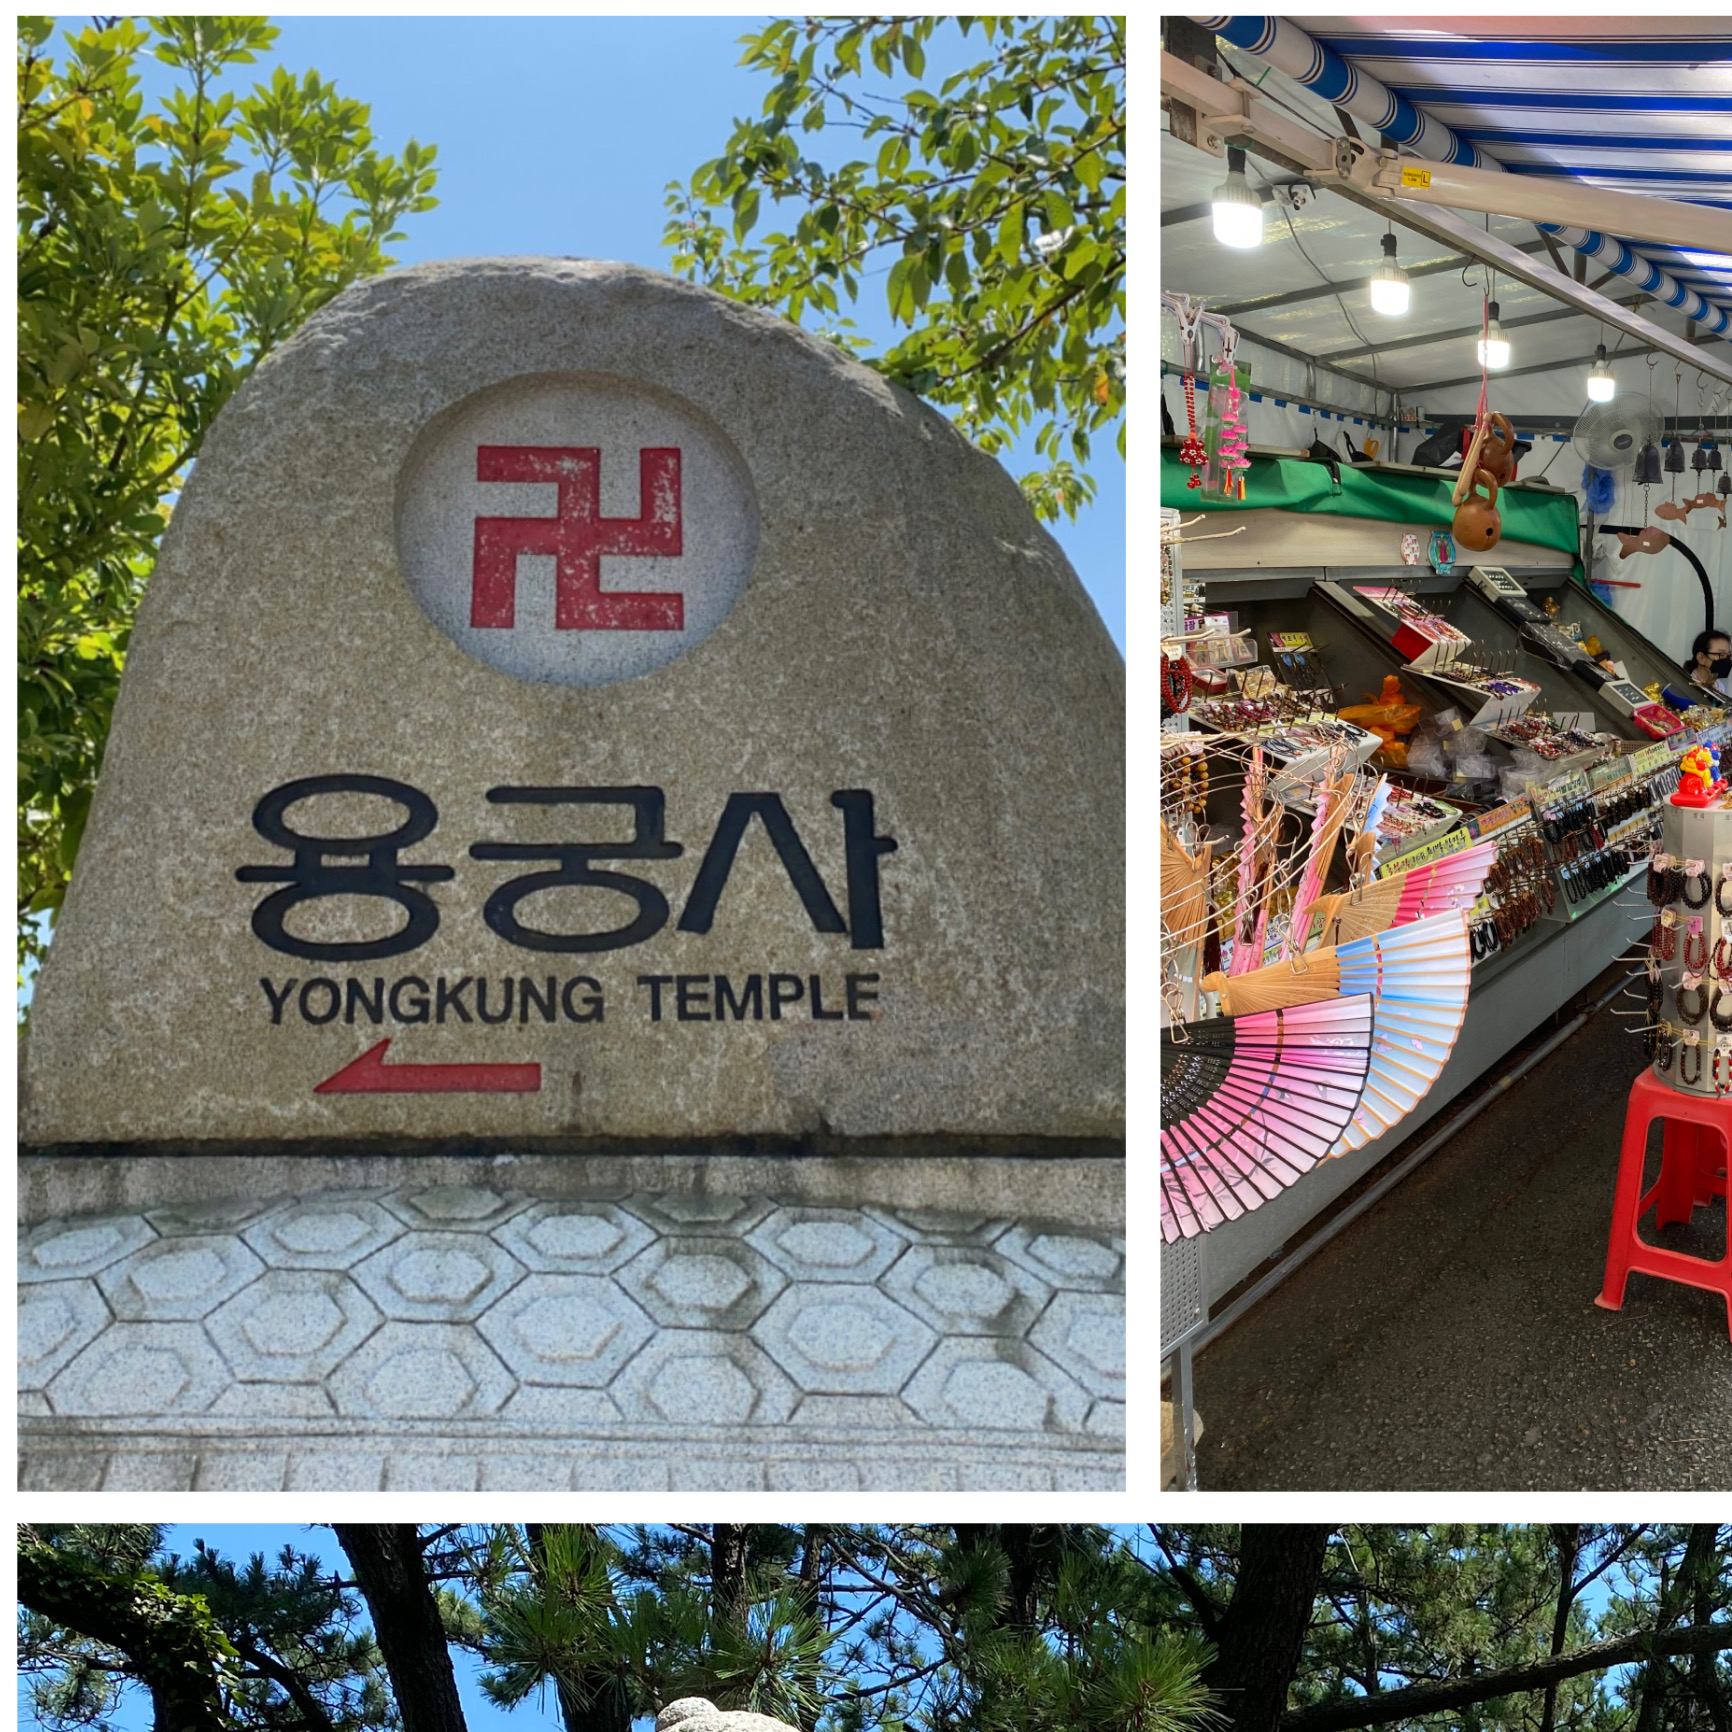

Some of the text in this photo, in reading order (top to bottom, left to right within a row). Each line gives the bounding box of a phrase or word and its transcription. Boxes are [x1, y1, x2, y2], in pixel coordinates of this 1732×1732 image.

[235, 773, 898, 961] 용궁사
[260, 972, 879, 1025] YONGKUNG TEMPLE
